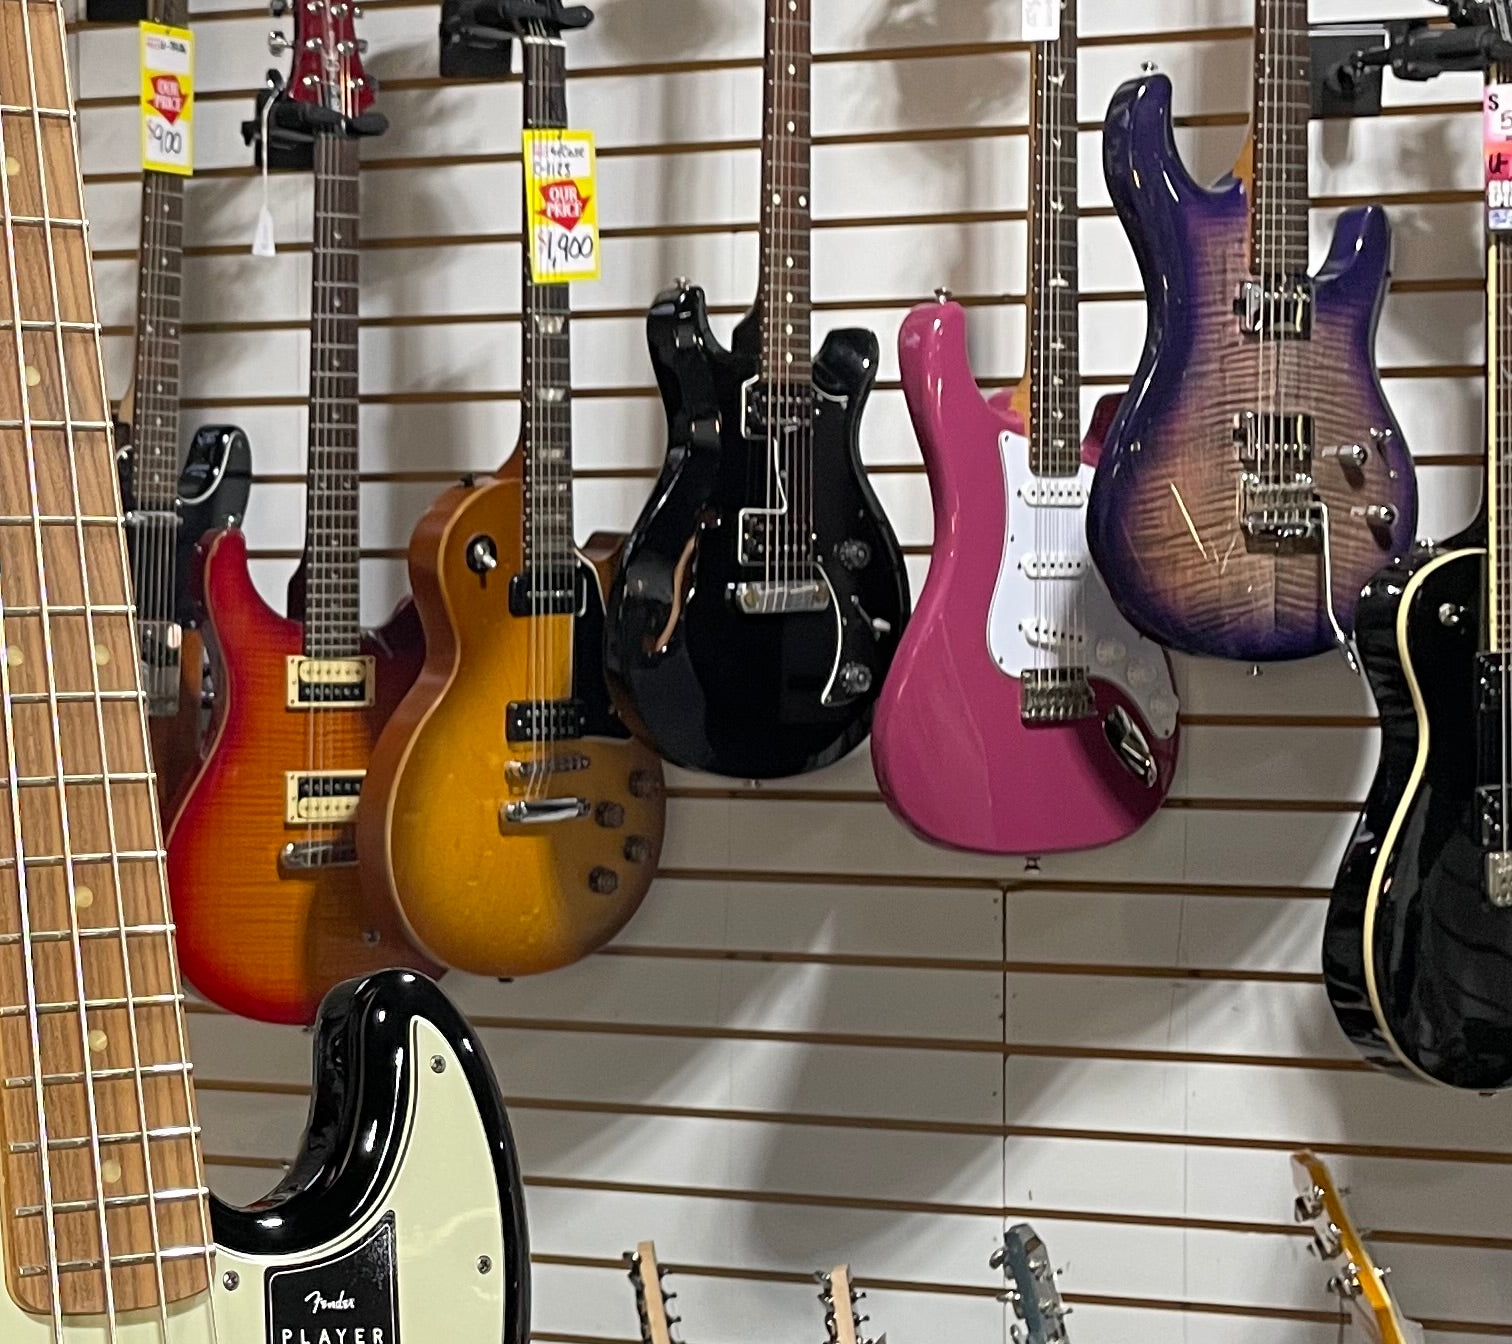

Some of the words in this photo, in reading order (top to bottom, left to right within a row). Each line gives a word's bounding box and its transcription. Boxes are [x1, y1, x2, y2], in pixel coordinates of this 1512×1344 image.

[549, 185, 578, 201] OUR
[546, 200, 583, 218] PRICE
[304, 1290, 356, 1314] Fender
